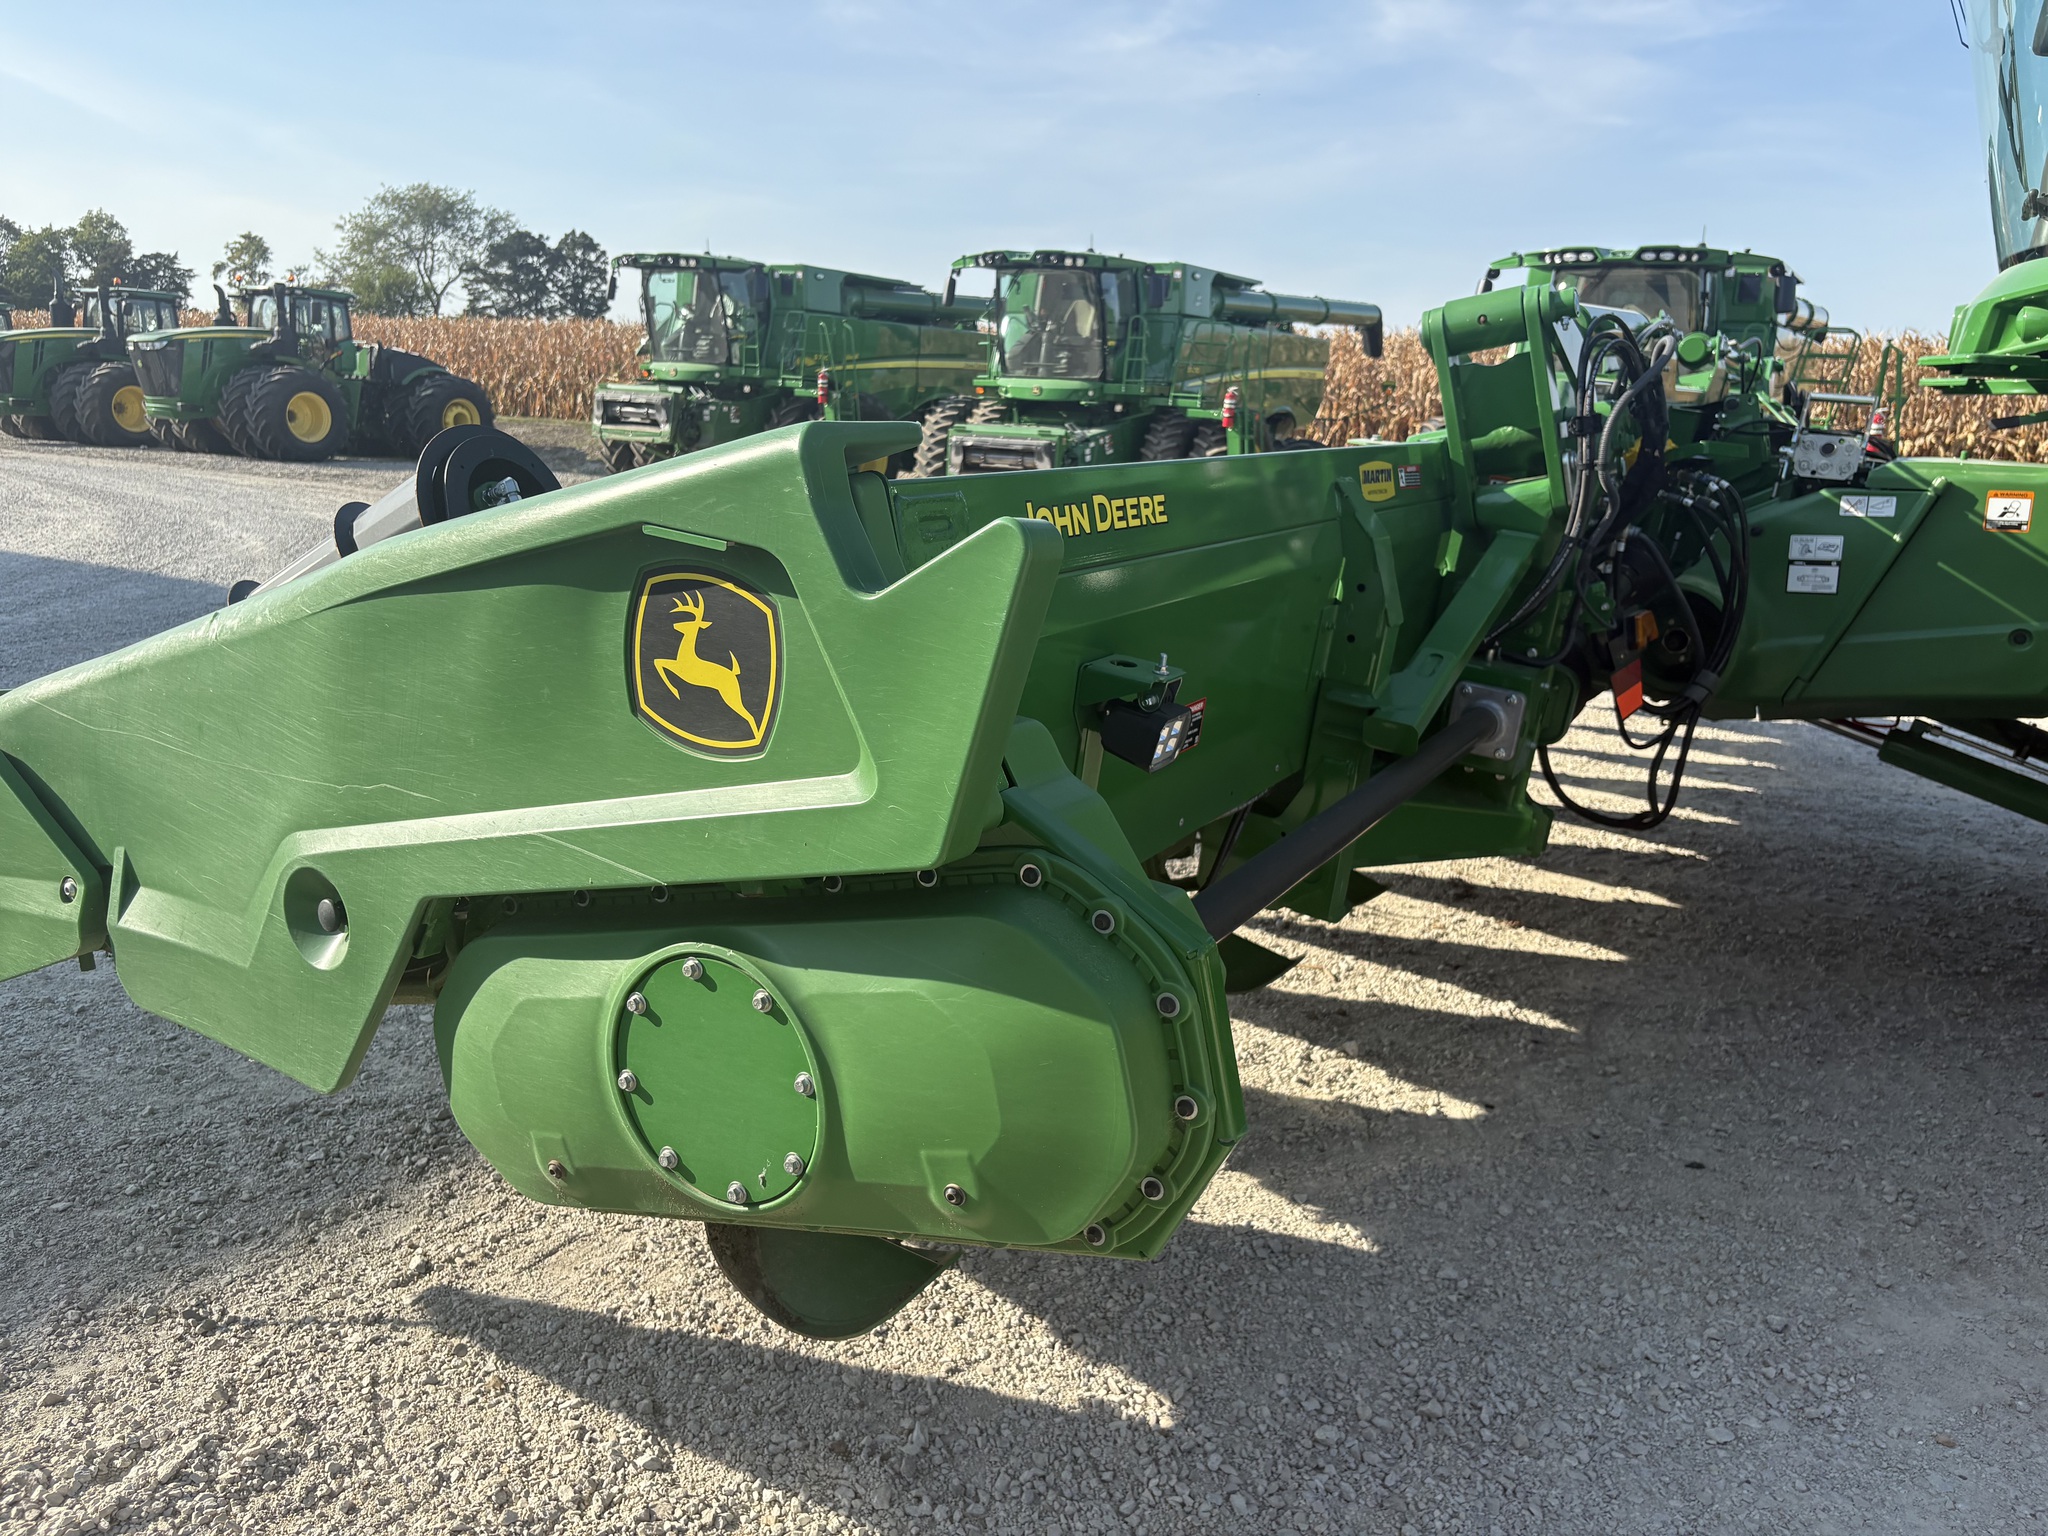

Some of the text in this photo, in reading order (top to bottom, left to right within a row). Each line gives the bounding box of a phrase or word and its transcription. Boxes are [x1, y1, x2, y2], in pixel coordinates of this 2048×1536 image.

[1362, 469, 1392, 484] MARTIN
[1092, 494, 1168, 533] DEERE
[1189, 701, 1204, 712] NGER
